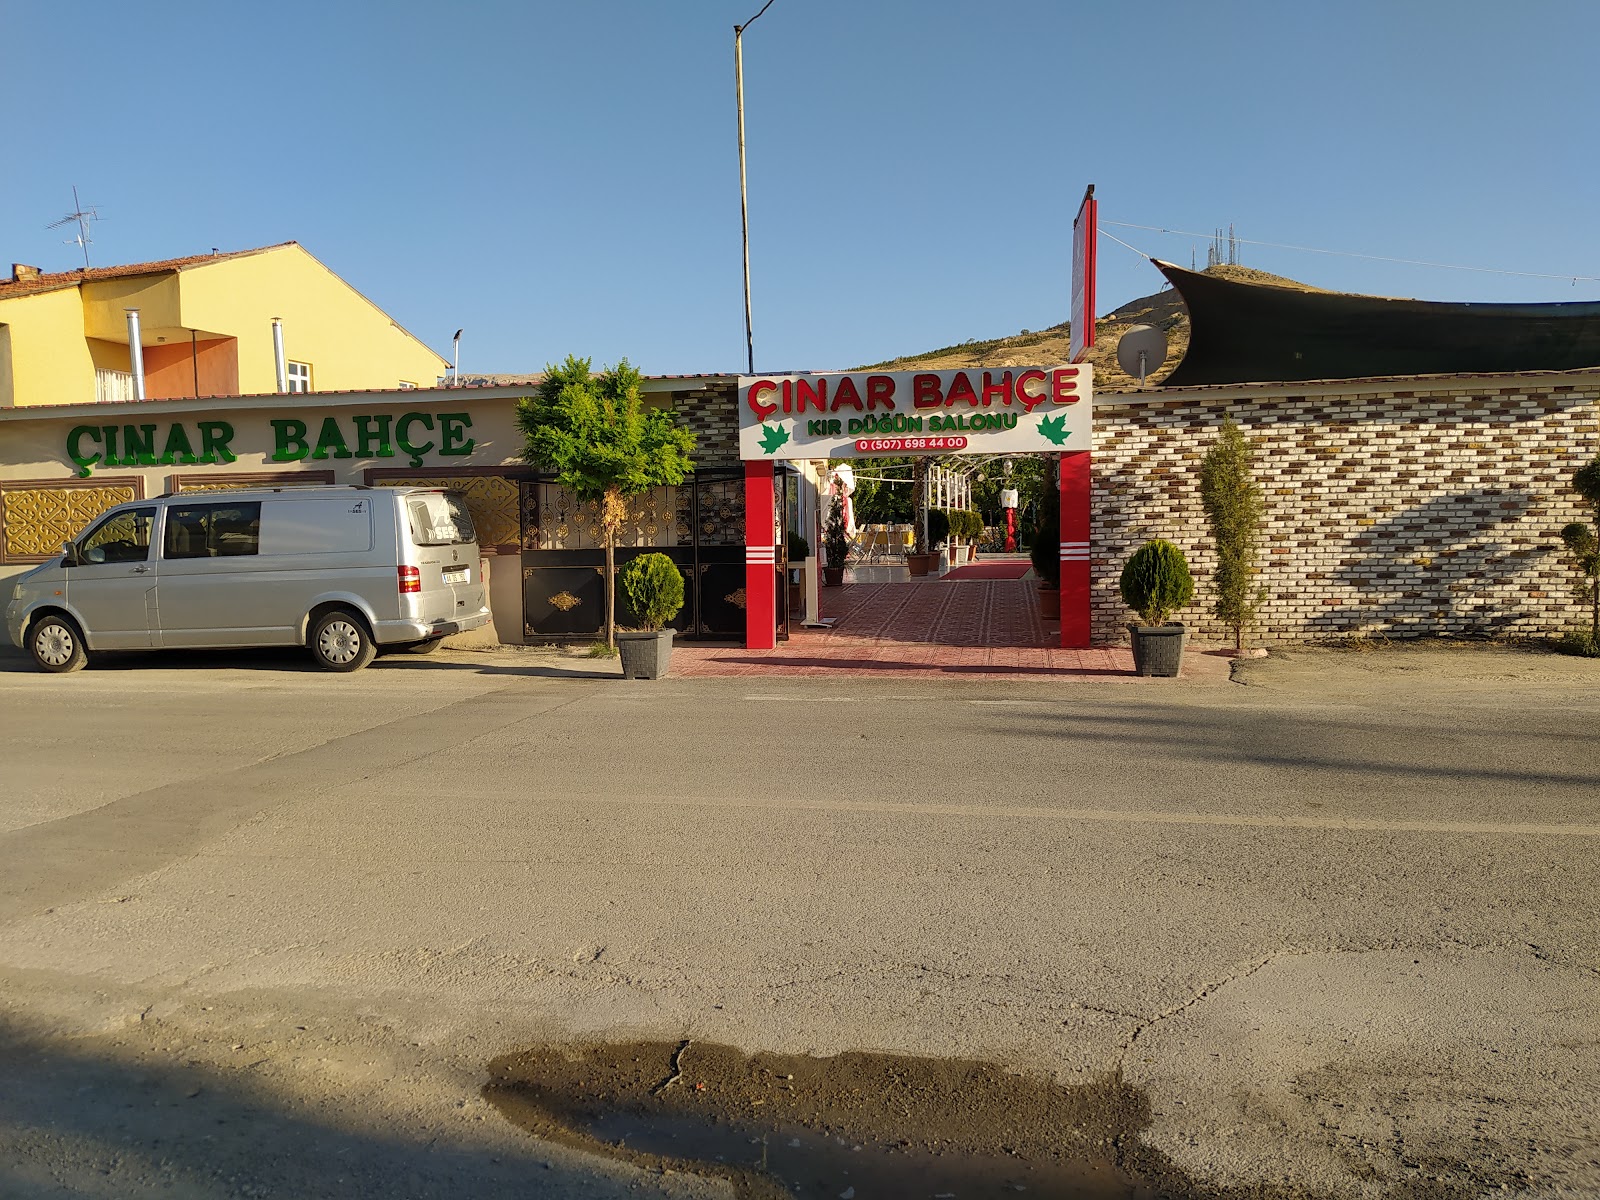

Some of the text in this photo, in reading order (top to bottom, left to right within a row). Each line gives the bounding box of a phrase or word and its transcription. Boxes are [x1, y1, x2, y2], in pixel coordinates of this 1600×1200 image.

[747, 368, 1080, 422] ÇINAR BAHÇE
[808, 412, 1017, 436] KIR DÜĞÜN SALONU
[67, 412, 476, 477] ÇINAR BAHÇE
[859, 437, 964, 451] 0 (507) 698 44 00
